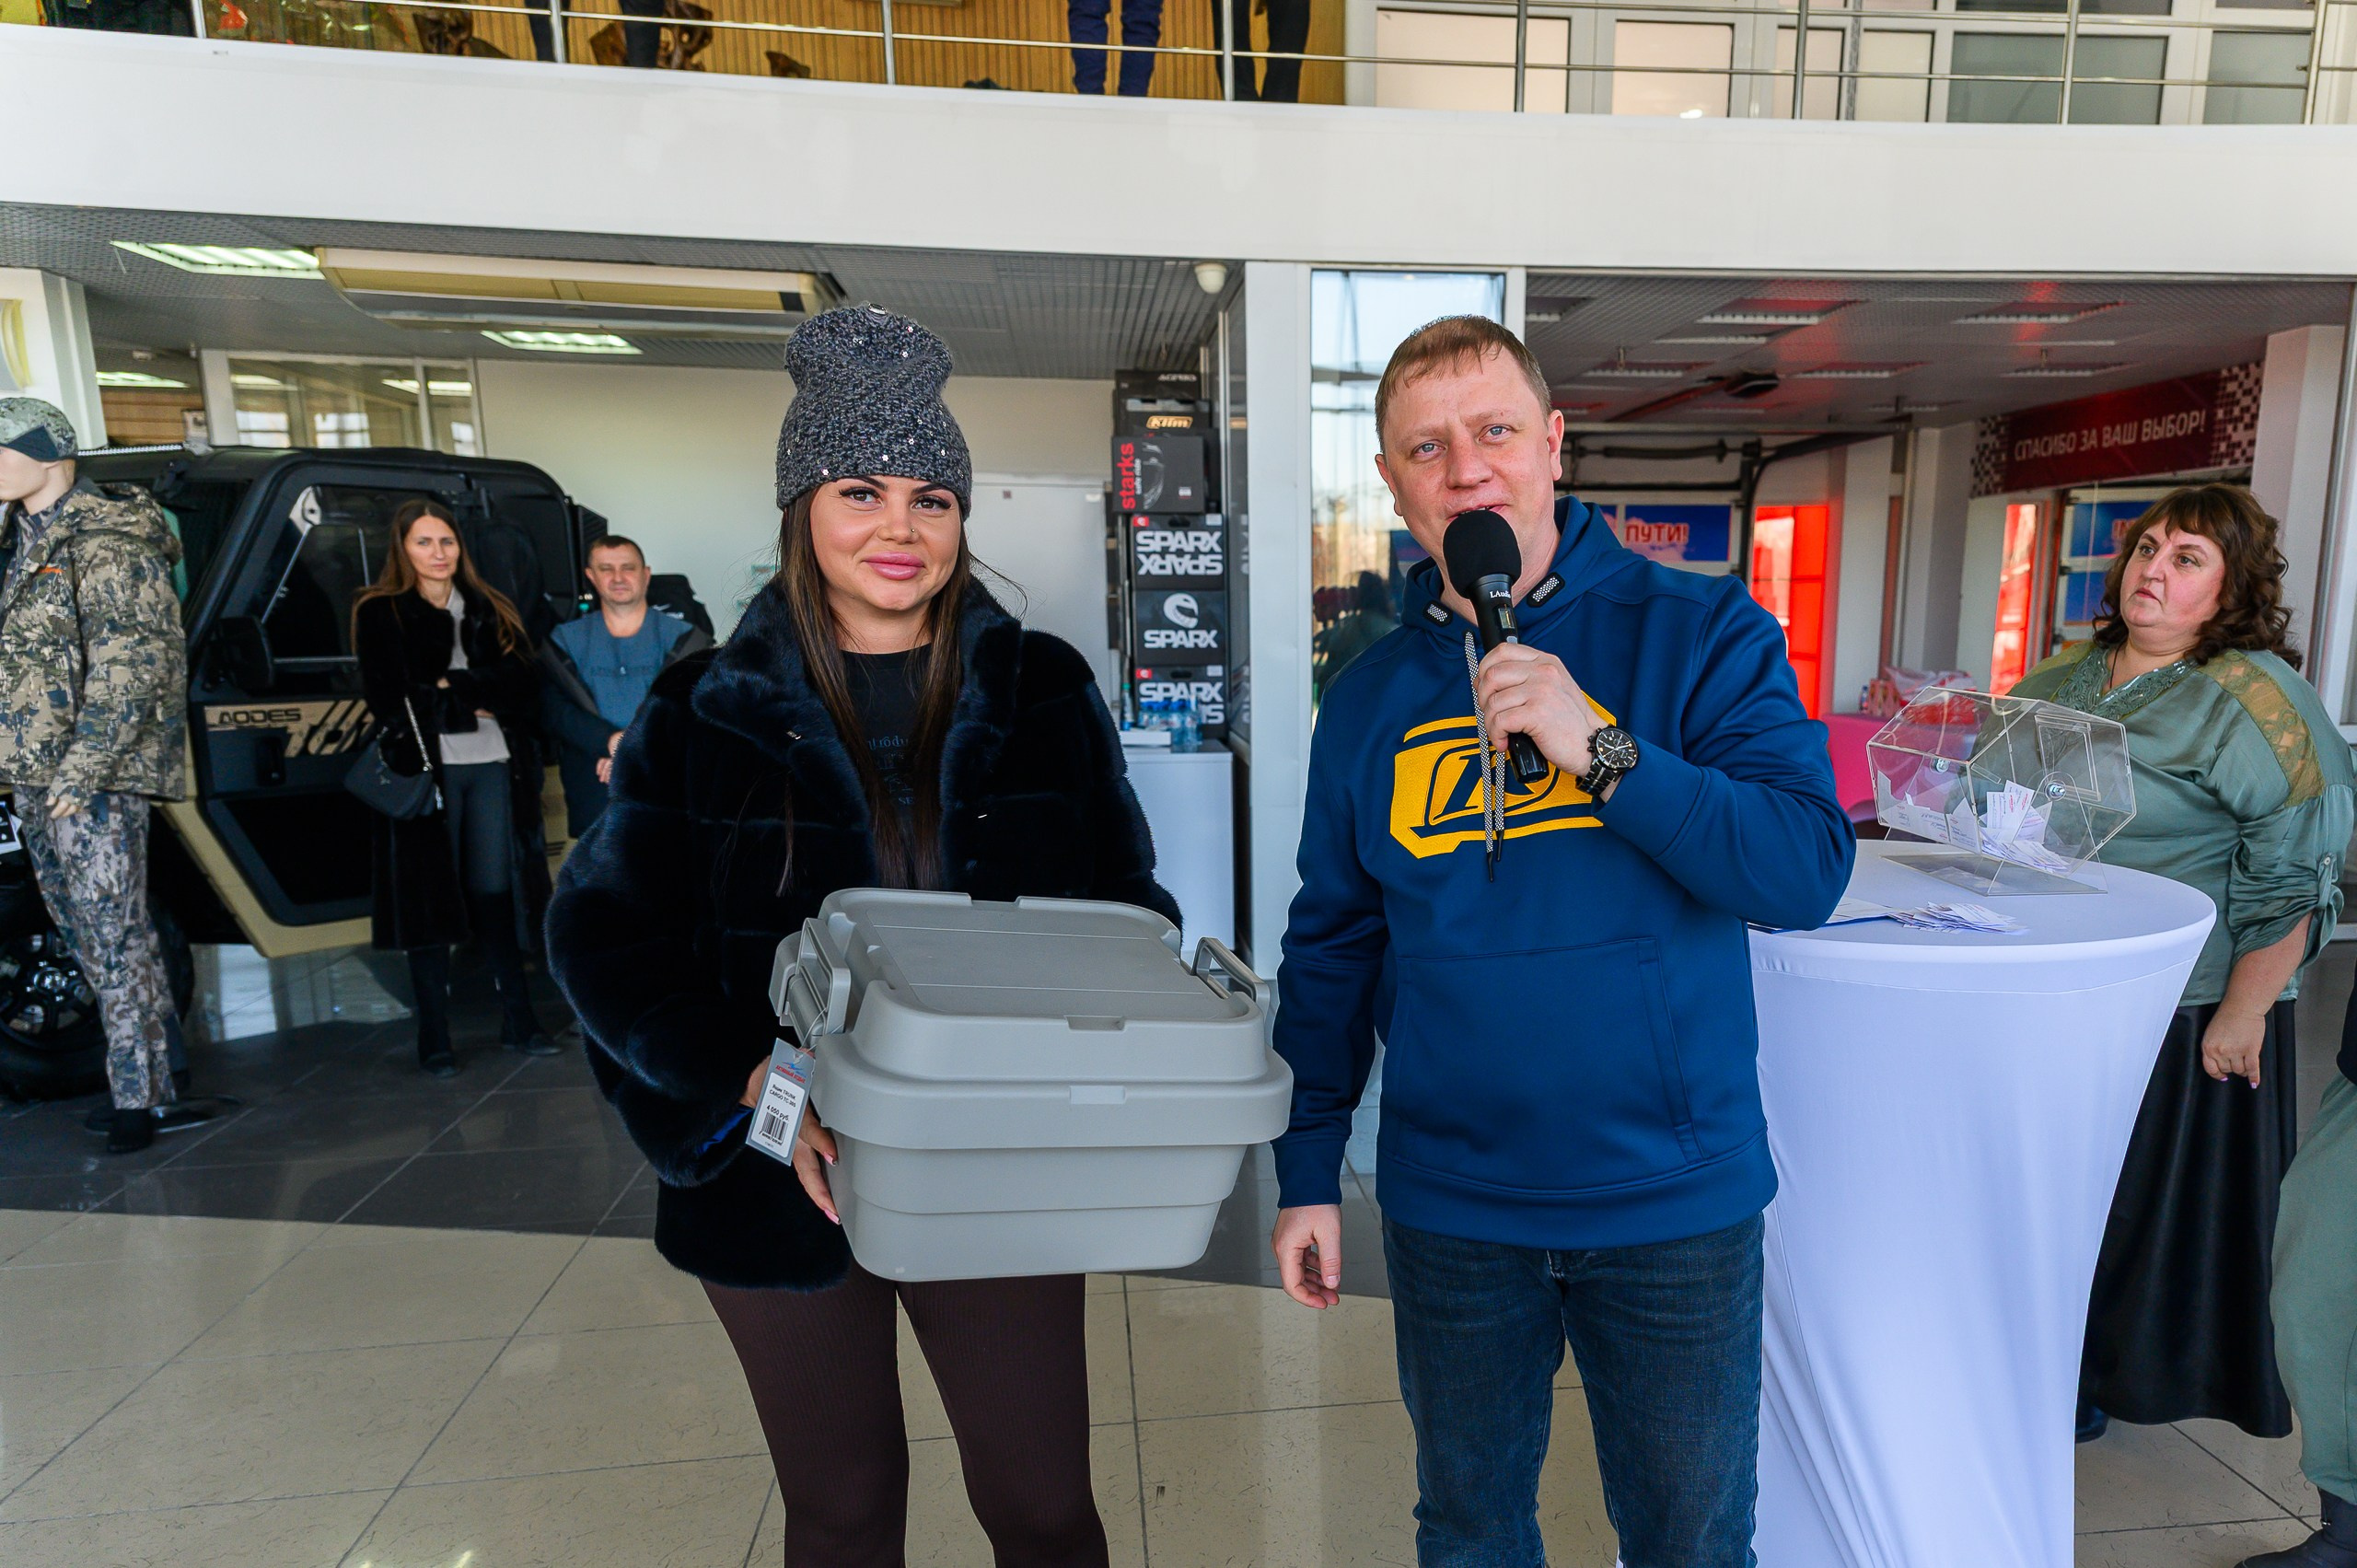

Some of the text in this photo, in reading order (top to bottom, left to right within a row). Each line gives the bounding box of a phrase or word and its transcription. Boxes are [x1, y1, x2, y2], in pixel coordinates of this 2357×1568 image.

[2014, 409, 2206, 461] СПАСИБО ЗА ВАШ ВЫБОР!
[1117, 442, 1136, 509] starks
[1135, 530, 1223, 552] SPARX
[1625, 523, 1689, 543] ПУТИ!
[1137, 553, 1224, 575] SPARX
[1144, 630, 1218, 648] SPARX
[1139, 682, 1224, 703] SPARX
